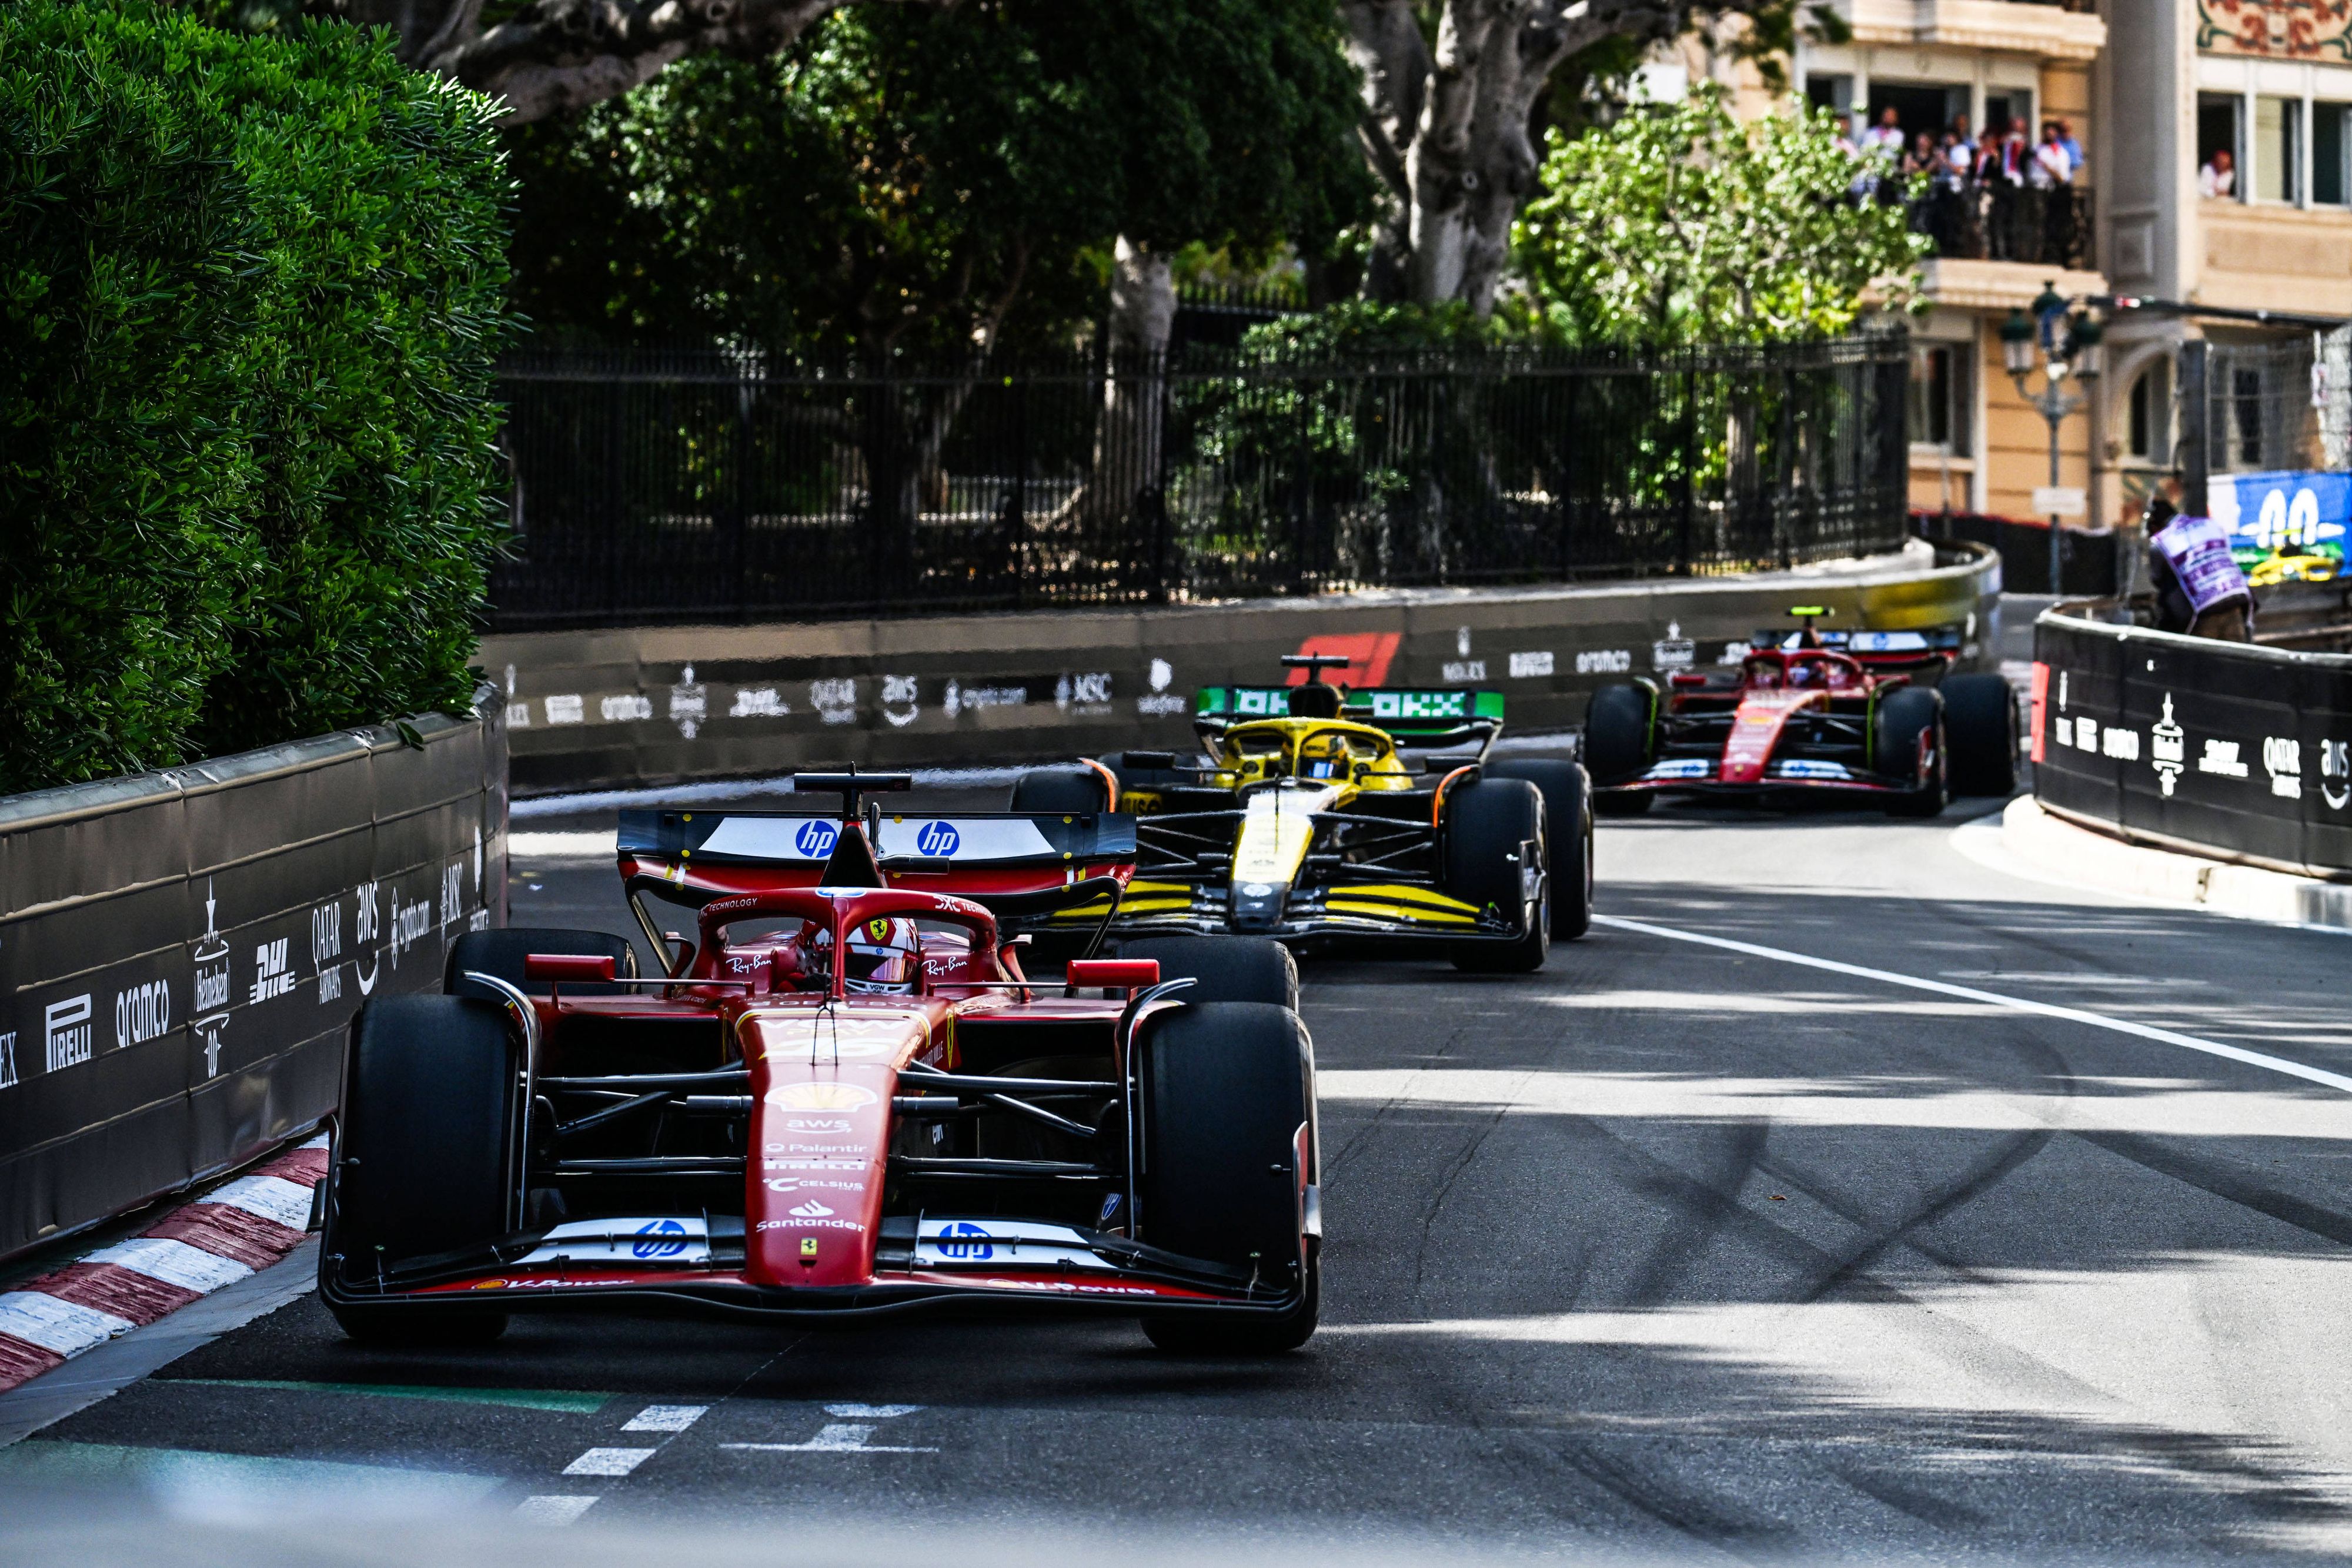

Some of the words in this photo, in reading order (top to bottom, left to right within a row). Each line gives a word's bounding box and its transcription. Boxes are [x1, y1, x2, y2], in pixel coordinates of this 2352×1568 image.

[1373, 691, 1465, 717] OKX
[798, 820, 836, 858] hp
[919, 821, 958, 856] hp
[357, 881, 378, 944] aws
[709, 898, 757, 912] TECHNOLOGY
[312, 901, 340, 976] QATAR
[249, 937, 295, 1005] DHL
[726, 954, 772, 974] Ray-Ban
[921, 956, 967, 975] Ray-Ban
[196, 964, 228, 1012] Heineken
[116, 979, 169, 1048] aramco
[45, 993, 92, 1073] PIRELLI
[786, 1119, 850, 1128] aws
[789, 1144, 867, 1153] Palantir
[799, 1181, 864, 1189] CELSIUS
[507, 1279, 635, 1289] V-Power
